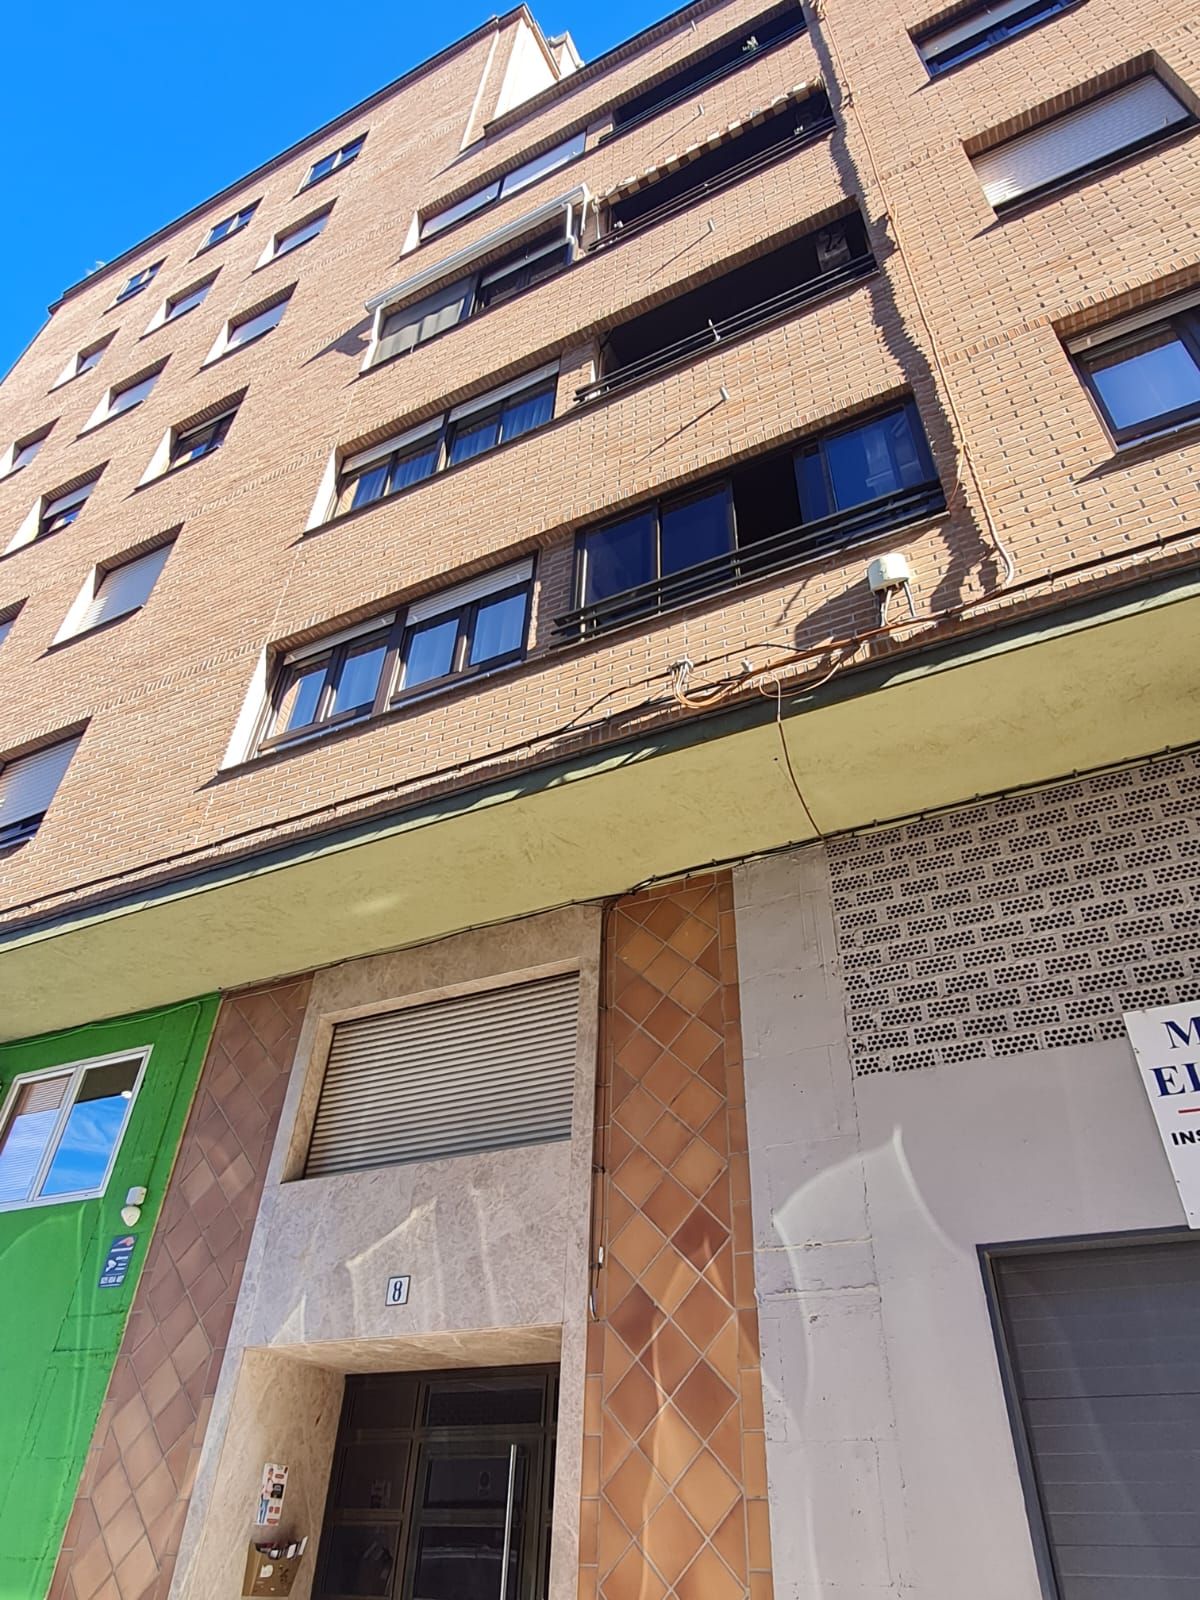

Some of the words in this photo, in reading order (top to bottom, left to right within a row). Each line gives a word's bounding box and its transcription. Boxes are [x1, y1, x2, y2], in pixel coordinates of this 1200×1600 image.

[1160, 1016, 1200, 1050] M
[1148, 1062, 1200, 1097] EL
[392, 1280, 403, 1302] 8
